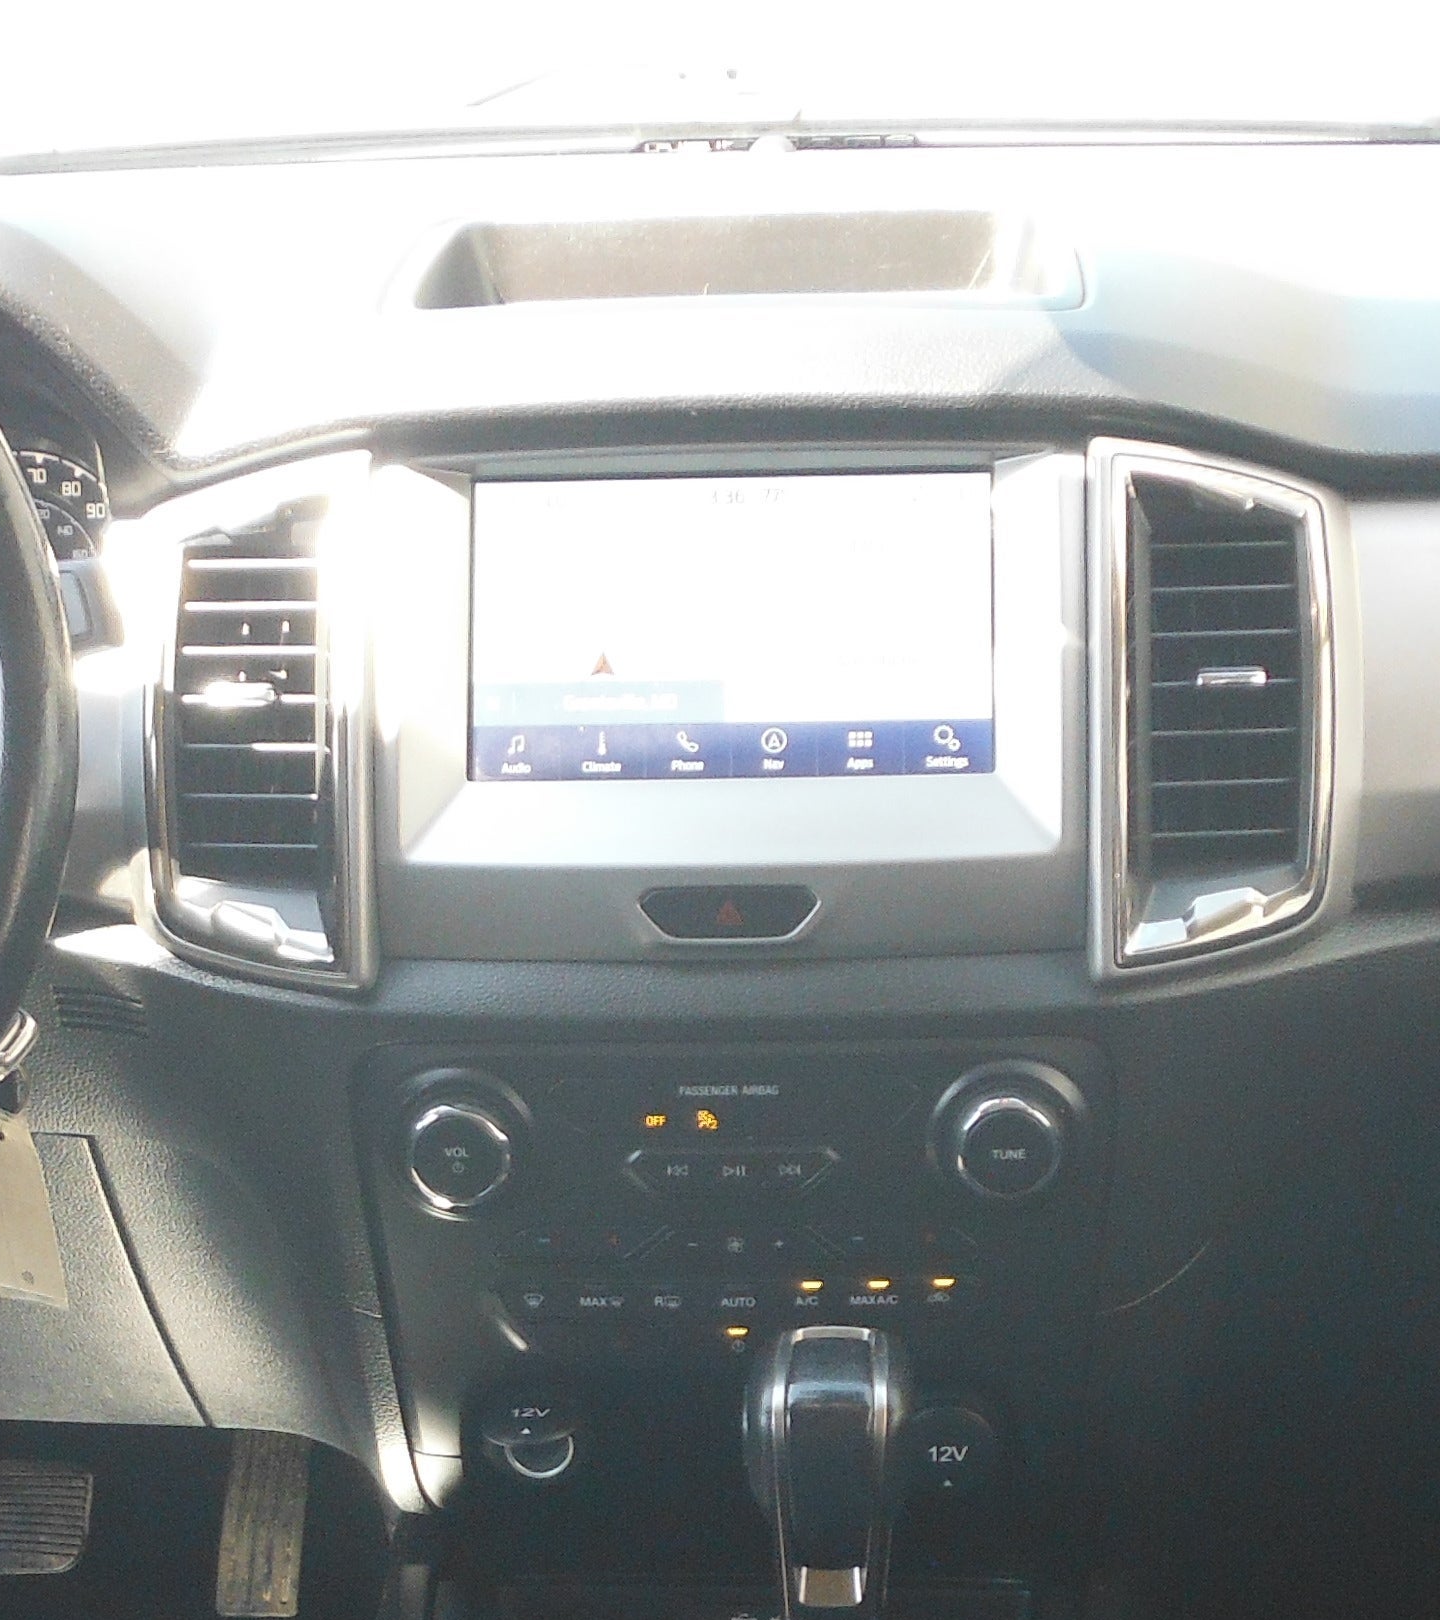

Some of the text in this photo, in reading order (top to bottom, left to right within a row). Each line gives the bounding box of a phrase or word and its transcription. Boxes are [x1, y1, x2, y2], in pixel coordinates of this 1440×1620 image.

[27, 467, 48, 484] 70
[60, 480, 82, 497] 80
[85, 502, 106, 519] 90
[501, 761, 532, 774] Audio
[581, 760, 622, 773] Climate
[671, 759, 705, 772] Phone
[762, 757, 785, 770] Nav
[846, 756, 875, 770] Apps
[925, 755, 970, 769] Settings
[678, 1084, 780, 1096] PASSENGER AIRBAG
[644, 1113, 668, 1128] OFF
[444, 1146, 469, 1158] VOL
[991, 1148, 1027, 1160] TUNE
[579, 1295, 608, 1307] MAX
[720, 1296, 757, 1308] AUTO
[795, 1295, 819, 1306] A/C
[850, 1294, 899, 1306] MAX A/C
[511, 1407, 551, 1418] 12V
[928, 1445, 969, 1462] 12V
